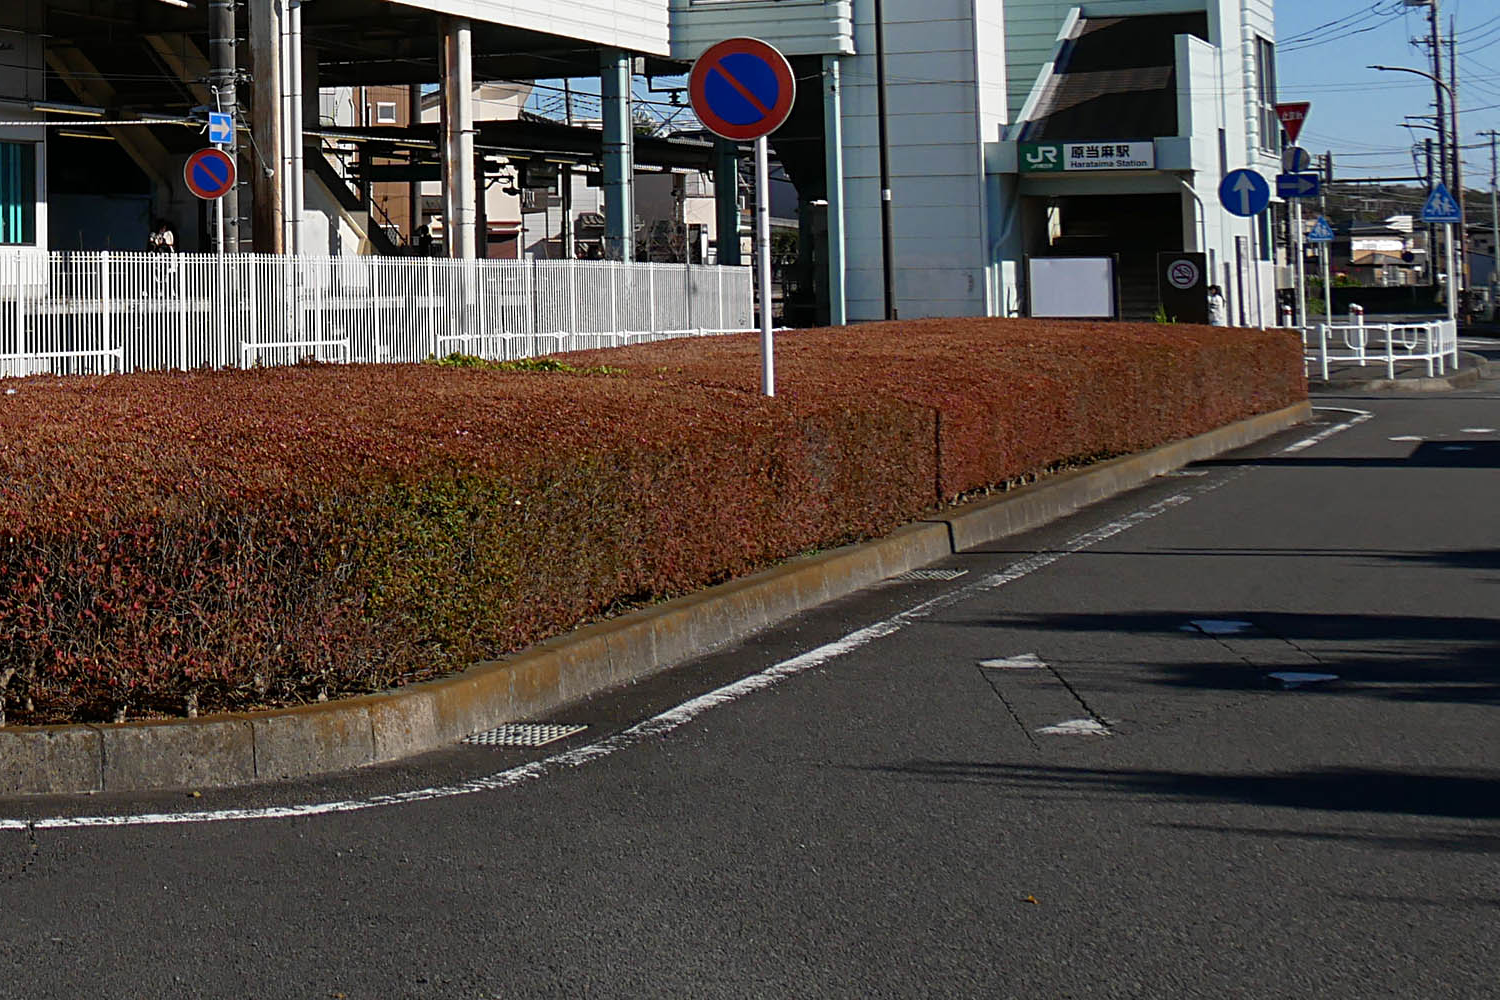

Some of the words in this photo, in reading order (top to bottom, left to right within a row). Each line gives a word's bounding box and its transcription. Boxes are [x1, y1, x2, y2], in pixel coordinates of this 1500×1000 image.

[1026, 146, 1058, 163] JR
[1071, 145, 1130, 159] 原当麻駅
[1116, 160, 1148, 168] Station
